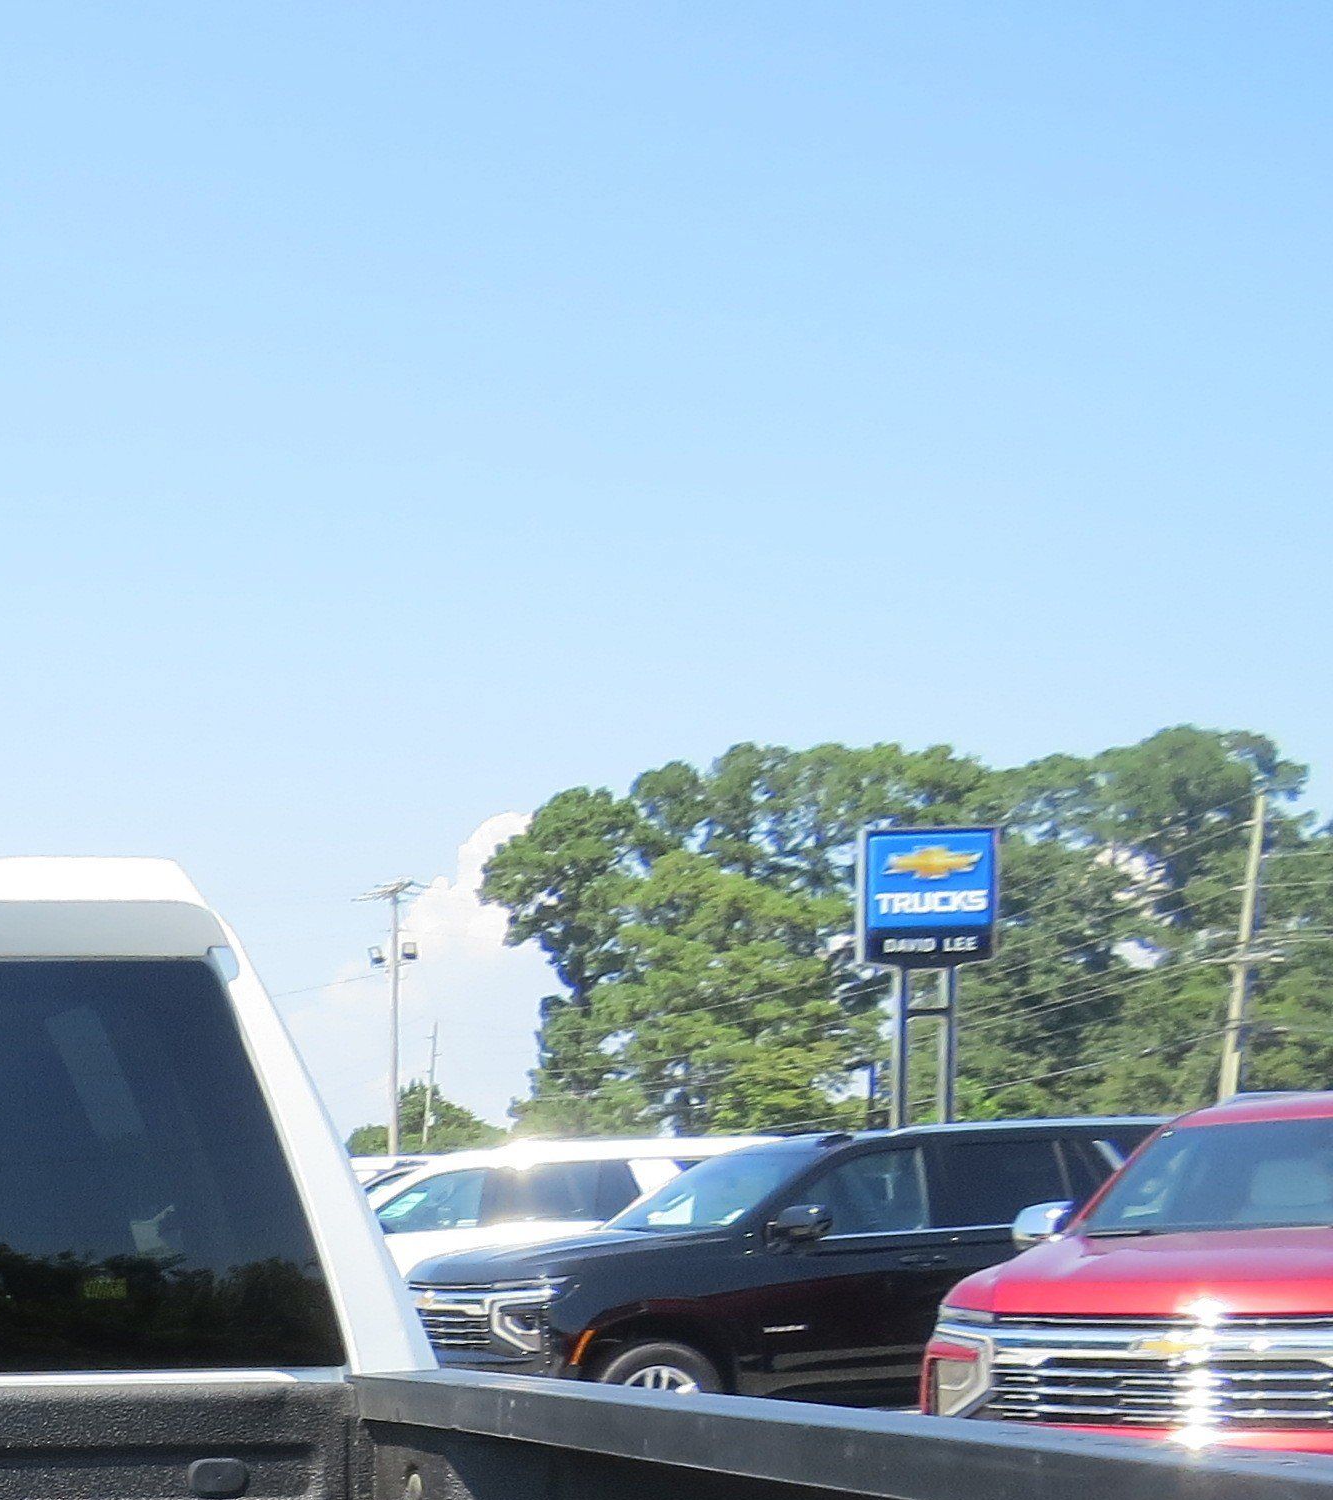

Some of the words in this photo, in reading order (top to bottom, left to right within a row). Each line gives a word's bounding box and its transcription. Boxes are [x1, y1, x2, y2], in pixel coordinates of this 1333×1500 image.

[874, 889, 989, 915] TRUCKS
[883, 937, 937, 953] DAVID
[942, 935, 979, 952] LEE
